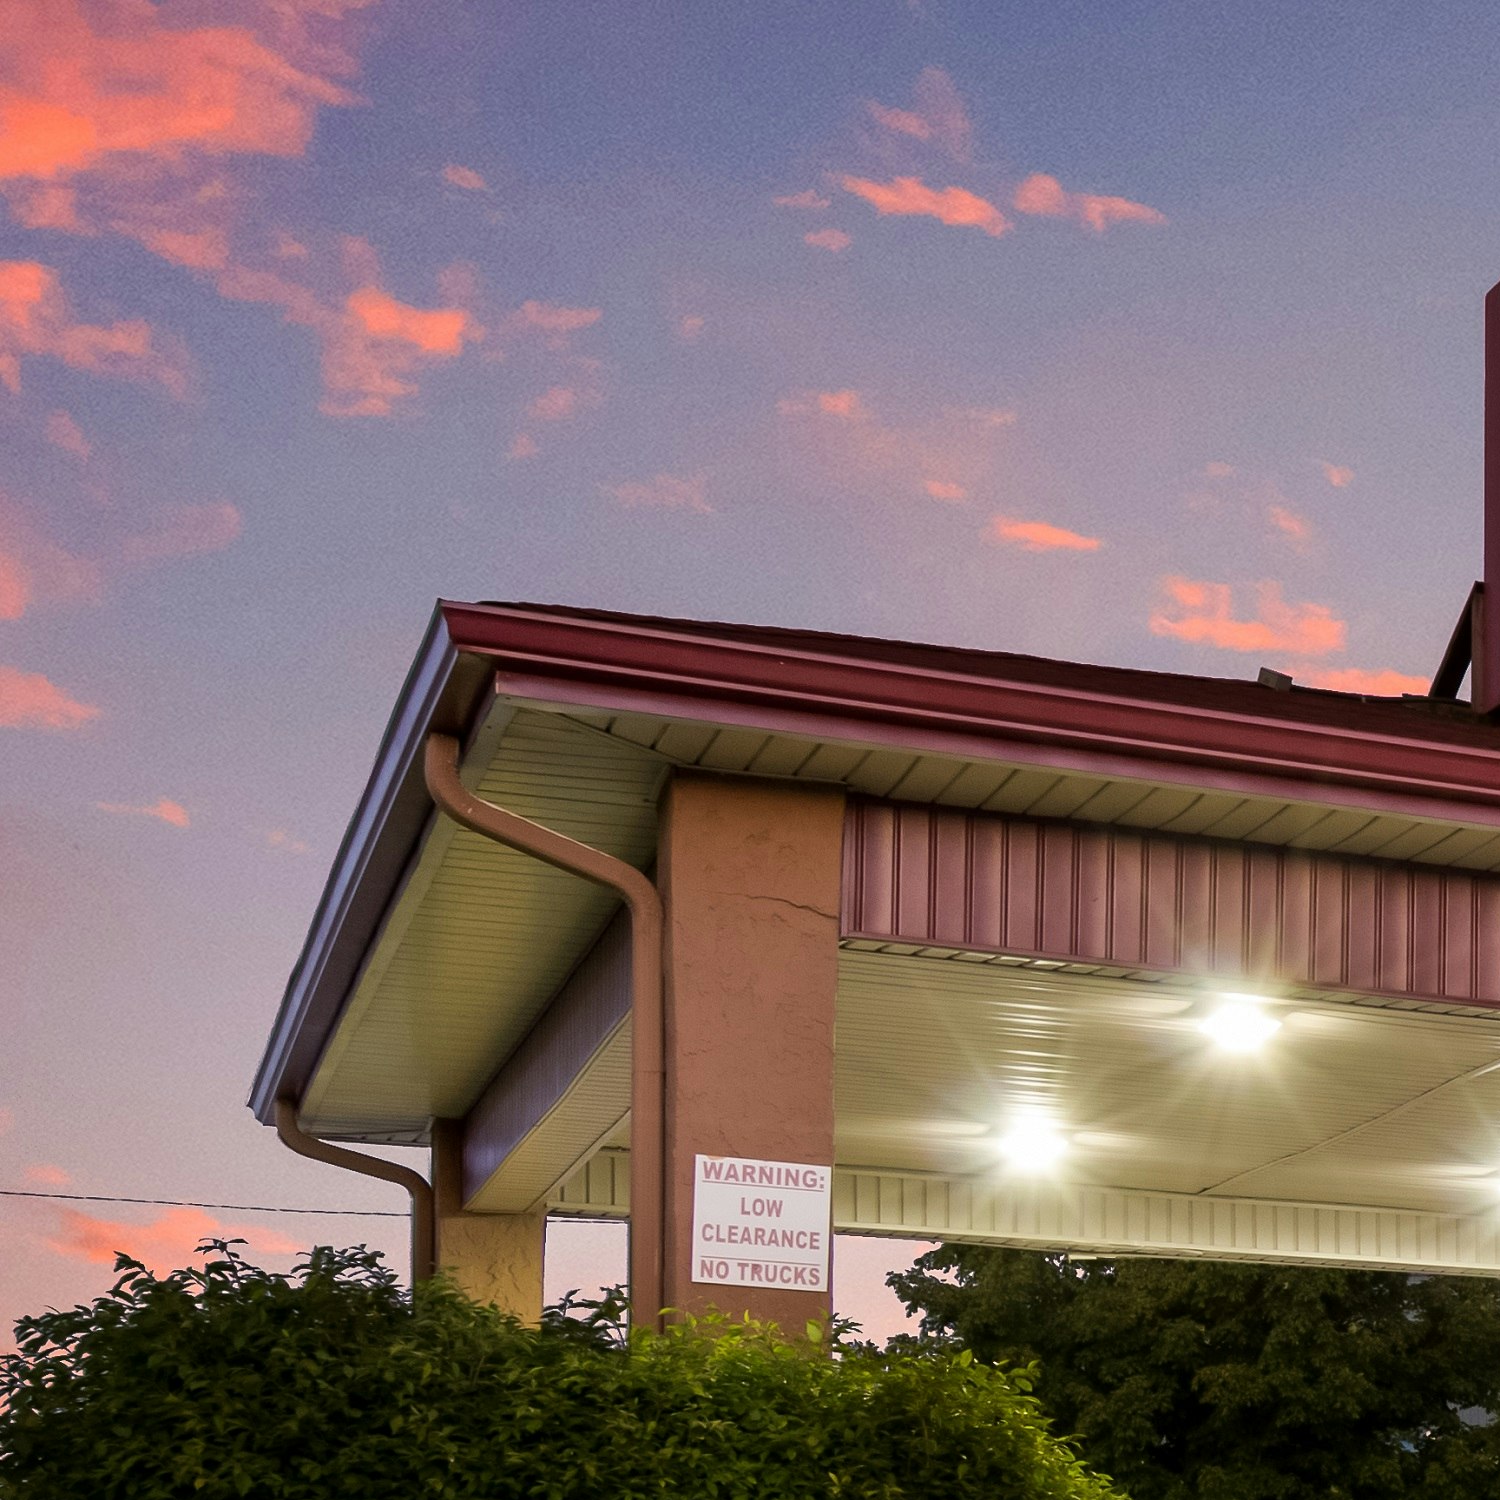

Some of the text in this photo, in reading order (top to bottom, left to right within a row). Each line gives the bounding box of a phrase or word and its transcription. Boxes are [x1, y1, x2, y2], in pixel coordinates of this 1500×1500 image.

[703, 1161, 825, 1189] WARNING:
[740, 1197, 783, 1217] LOW
[702, 1223, 820, 1250] CLEARANCE
[700, 1260, 820, 1286] NO TRUCKS
